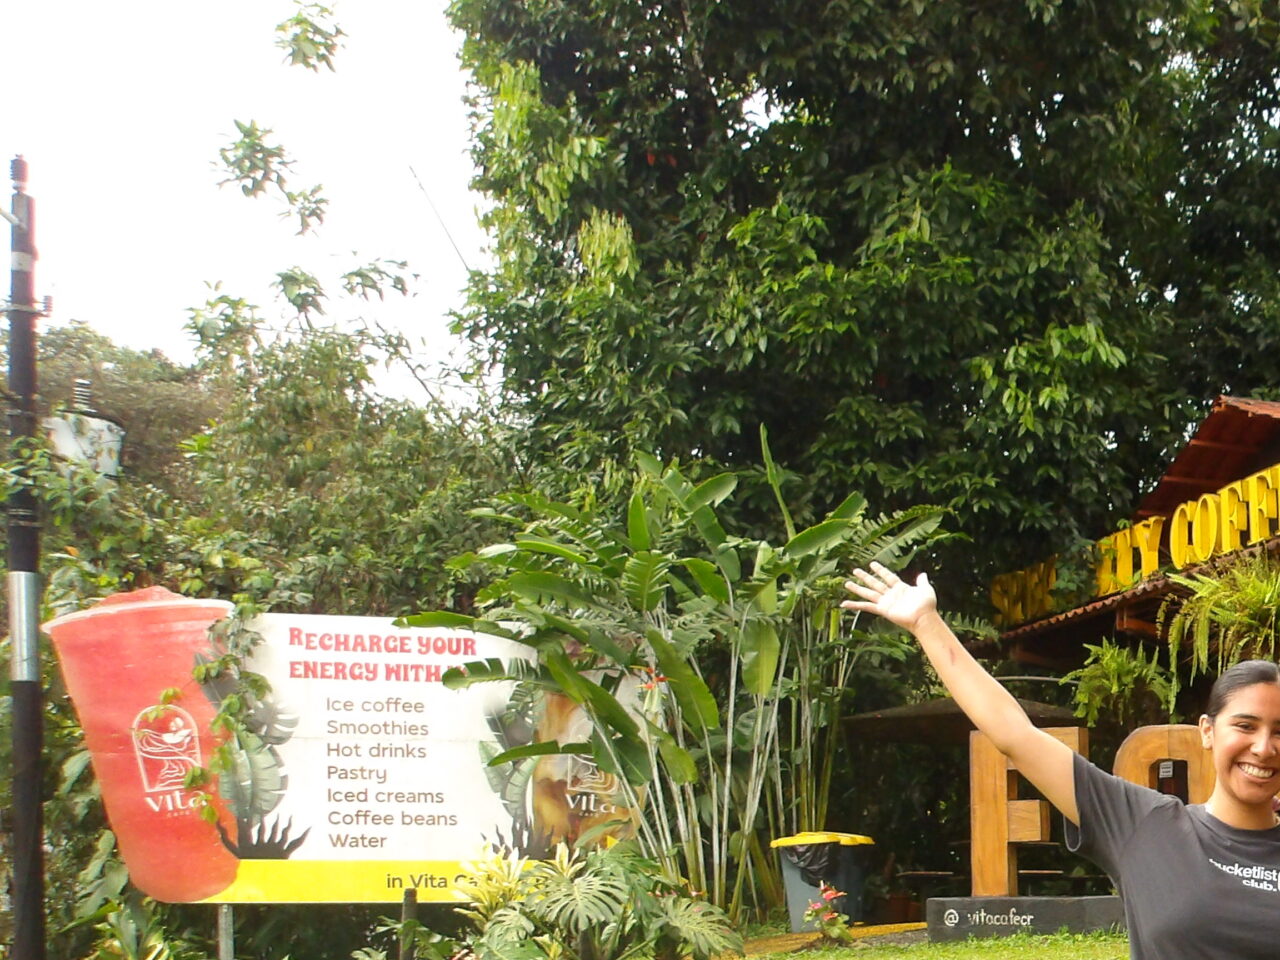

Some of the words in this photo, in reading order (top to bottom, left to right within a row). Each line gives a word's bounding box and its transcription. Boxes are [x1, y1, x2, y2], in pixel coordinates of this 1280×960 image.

[288, 627, 411, 653] RECHARGE
[417, 635, 477, 656] YOUR
[288, 660, 379, 682] ENERGY
[384, 663, 443, 683] WITH
[326, 697, 354, 712] Ice
[361, 697, 425, 713] coffee
[327, 720, 429, 736] Smoothies
[327, 742, 362, 757] Hot
[368, 743, 427, 759] drinks
[327, 765, 388, 784] Pastry
[327, 788, 369, 803] Iced
[375, 790, 445, 804] creams
[328, 809, 395, 826] Coffee
[401, 810, 458, 826] beans
[328, 833, 388, 848] Water
[386, 873, 403, 889] in
[409, 873, 448, 889] Vita
[1242, 878, 1278, 893] club.
[943, 908, 960, 928] @
[967, 907, 1035, 927] vitacafecr
